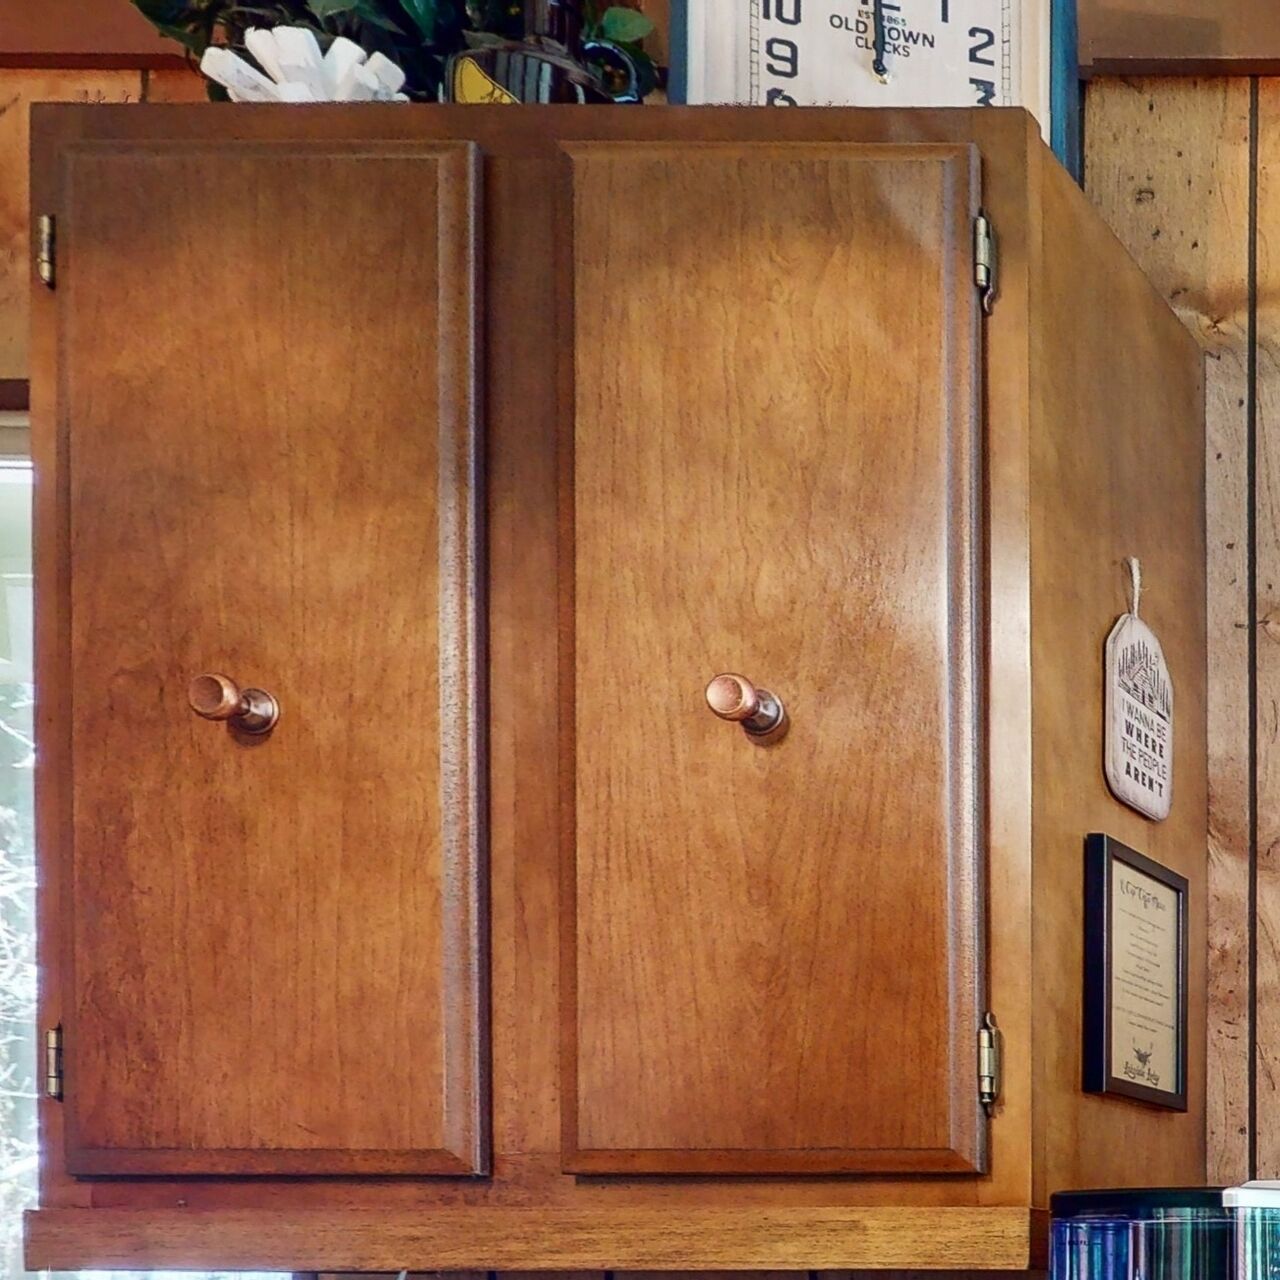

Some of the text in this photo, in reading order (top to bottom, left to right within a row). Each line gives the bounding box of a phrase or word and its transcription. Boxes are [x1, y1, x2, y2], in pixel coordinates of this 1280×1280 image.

[829, 14, 935, 48] OLD OWN
[855, 36, 911, 58] CLCKS
[968, 26, 995, 66] 2
[766, 37, 798, 79] 9
[1125, 719, 1164, 759] WHERE
[1126, 700, 1155, 733] WANNA
[1156, 723, 1166, 743] BE
[1122, 736, 1167, 781] THE PEOPLE
[1125, 761, 1163, 797] AREN'T
